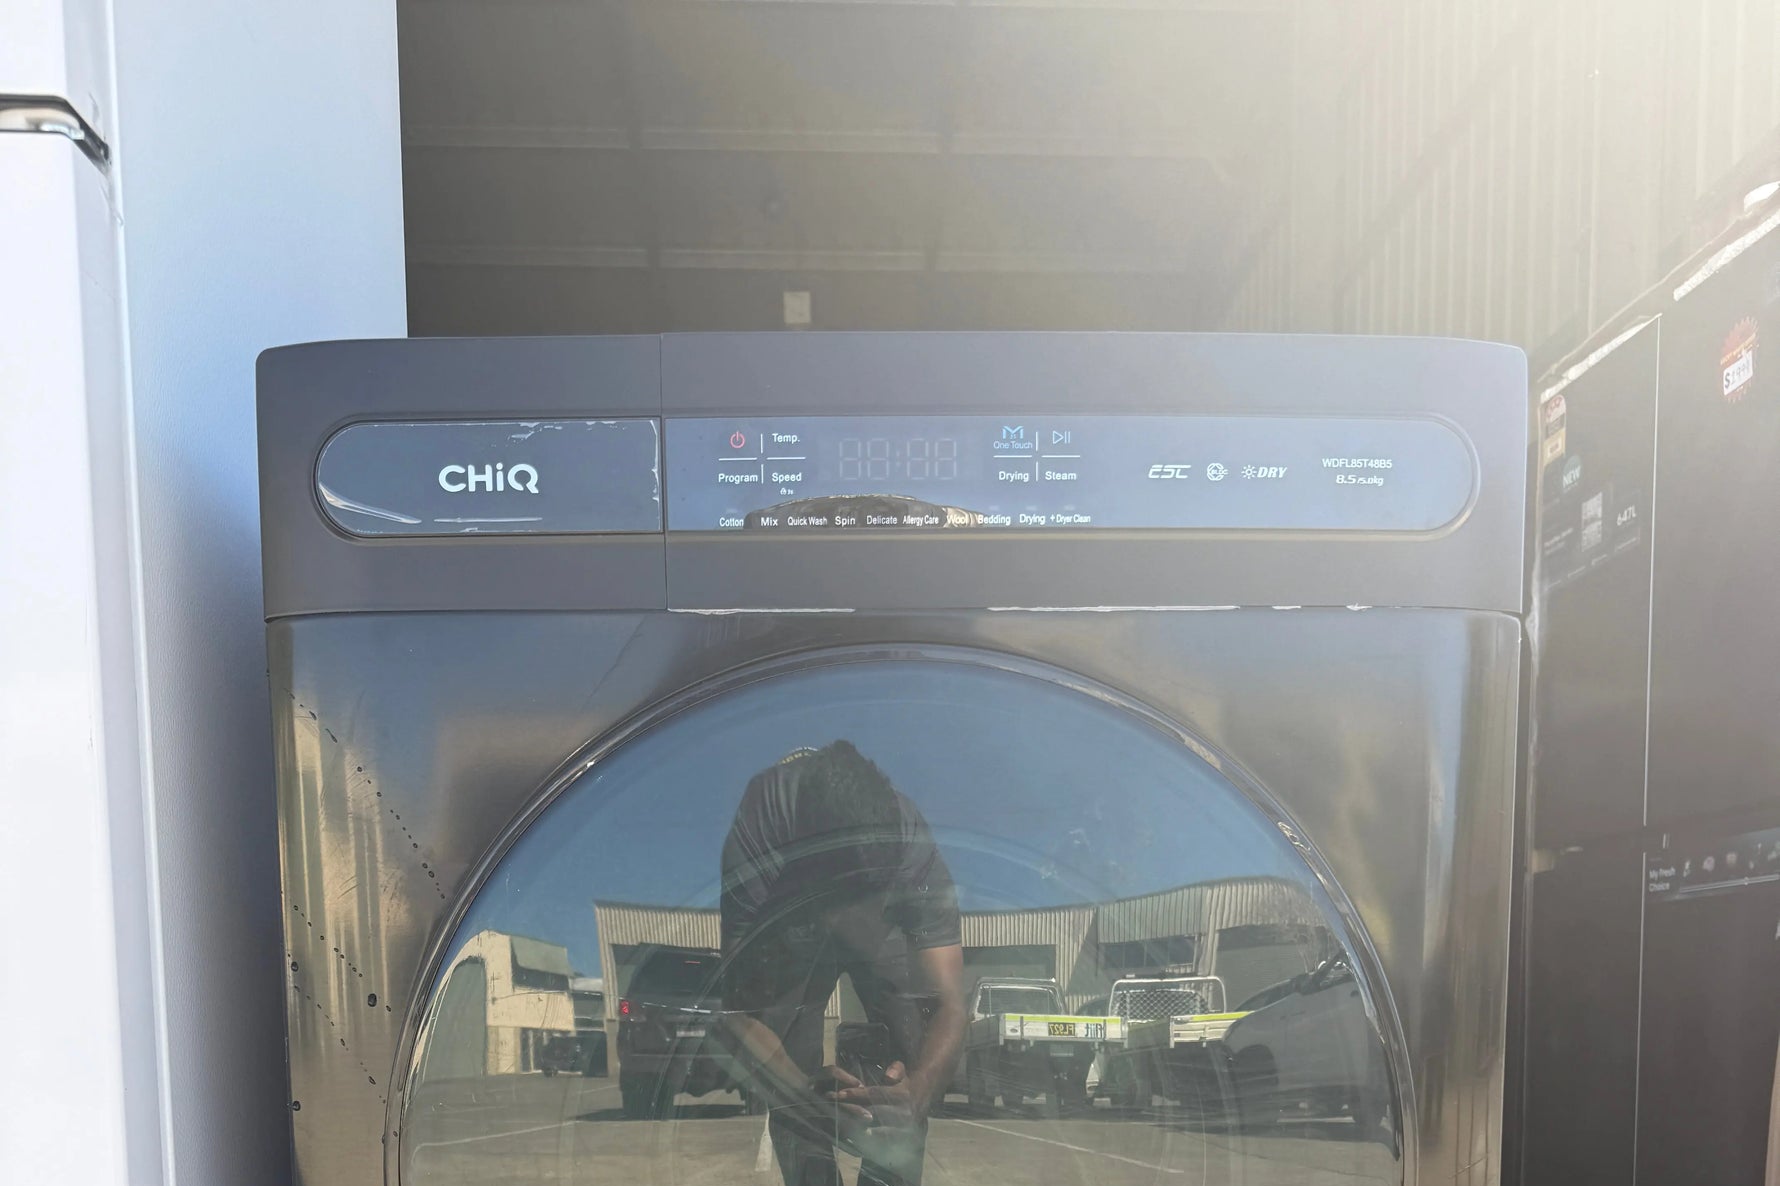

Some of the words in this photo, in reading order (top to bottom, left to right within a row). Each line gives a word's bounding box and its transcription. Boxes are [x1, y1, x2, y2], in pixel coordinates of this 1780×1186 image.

[772, 433, 800, 444] Temp.
[994, 441, 1009, 449] One
[1011, 441, 1032, 449] Touch
[1322, 458, 1392, 469] WDFL85T48B5
[999, 471, 1029, 482] Drying
[1045, 471, 1076, 480] Steam
[1257, 467, 1288, 478] DRY
[439, 462, 539, 494] CHiQ
[718, 473, 758, 484] Program
[772, 473, 802, 484] Speed
[720, 517, 744, 526] Cotton
[761, 517, 778, 526] Mix
[788, 516, 807, 526] Quick
[808, 516, 827, 525] Wash
[835, 516, 855, 526] Spin
[867, 515, 897, 525] Delicate
[902, 516, 923, 526] Allergy
[924, 515, 938, 524] Care
[946, 514, 968, 524] Wool
[978, 514, 1011, 526] Bedding
[1020, 514, 1045, 524] Drying
[1074, 514, 1090, 523] Clean
